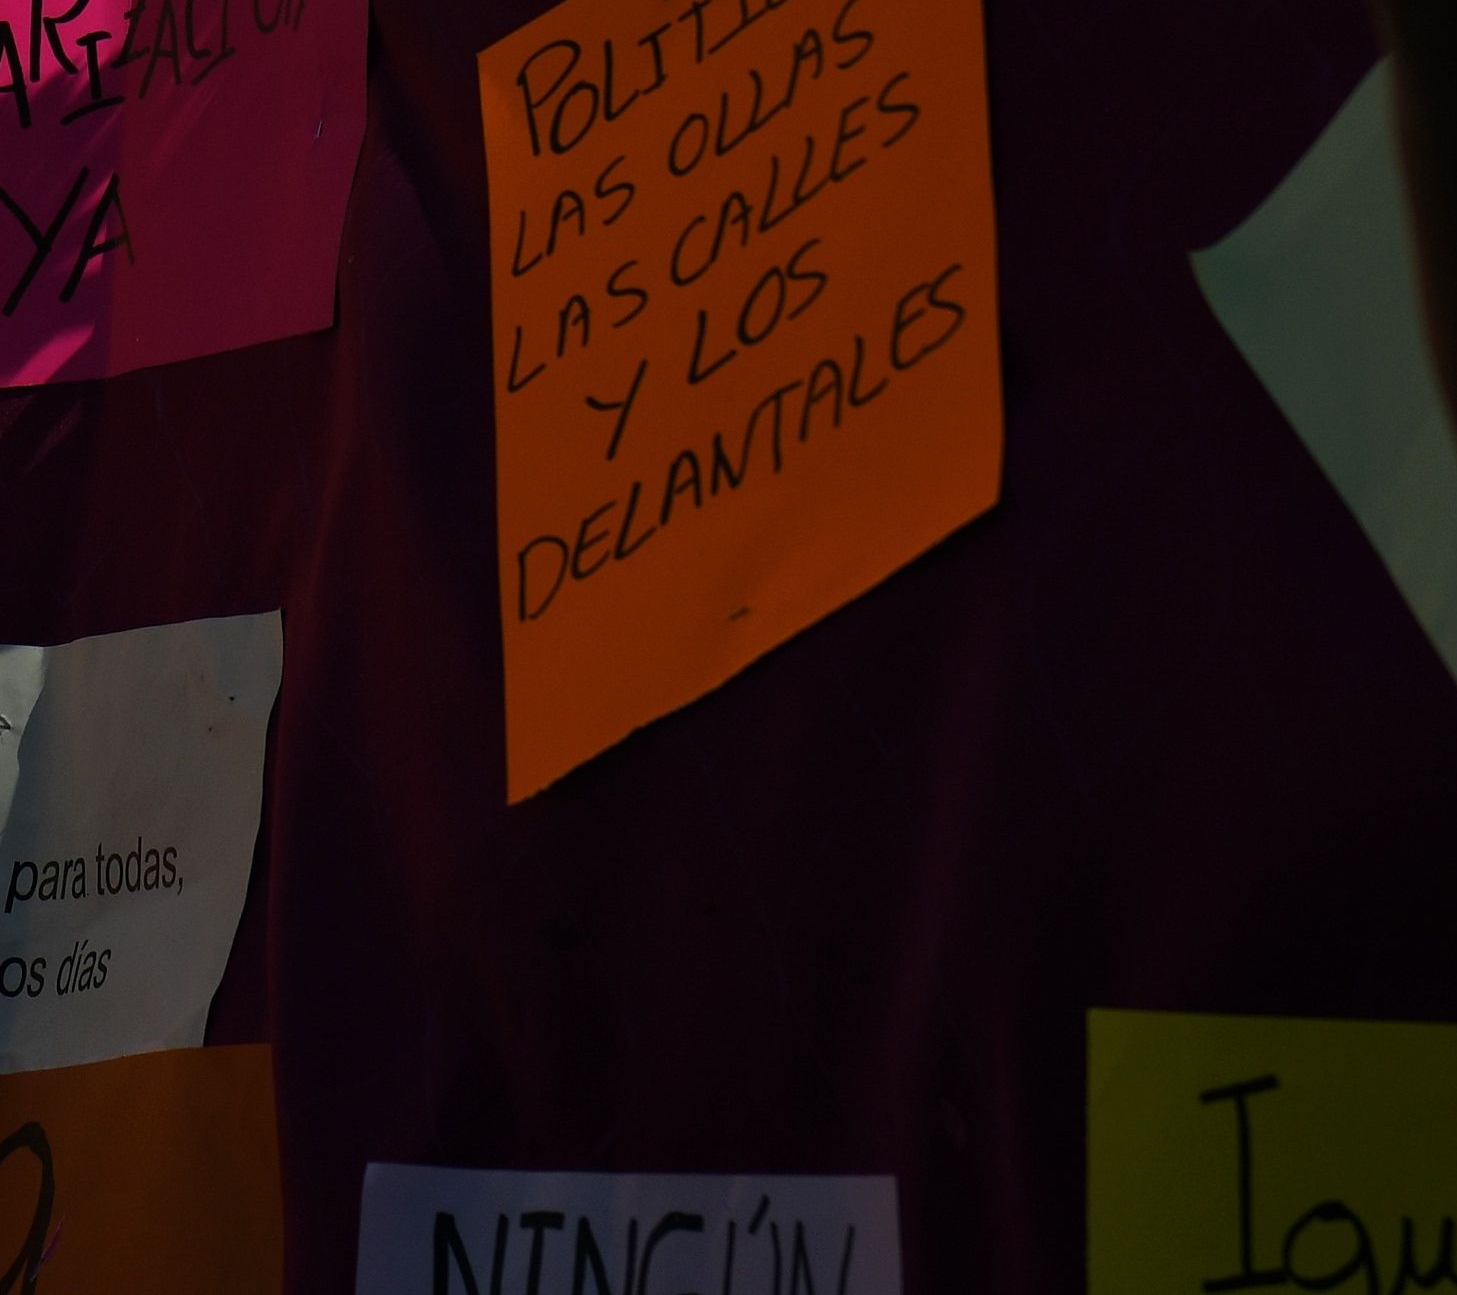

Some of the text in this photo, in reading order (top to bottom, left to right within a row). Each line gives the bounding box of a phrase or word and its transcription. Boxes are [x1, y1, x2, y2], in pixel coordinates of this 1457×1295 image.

[506, 71, 922, 394] LAS CALLES
[510, 155, 636, 279] LAS
[584, 239, 829, 461] Y LOS
[516, 264, 968, 625] DELANTALES
[4, 853, 87, 913] para
[95, 835, 185, 899] todas,
[56, 939, 112, 996] días
